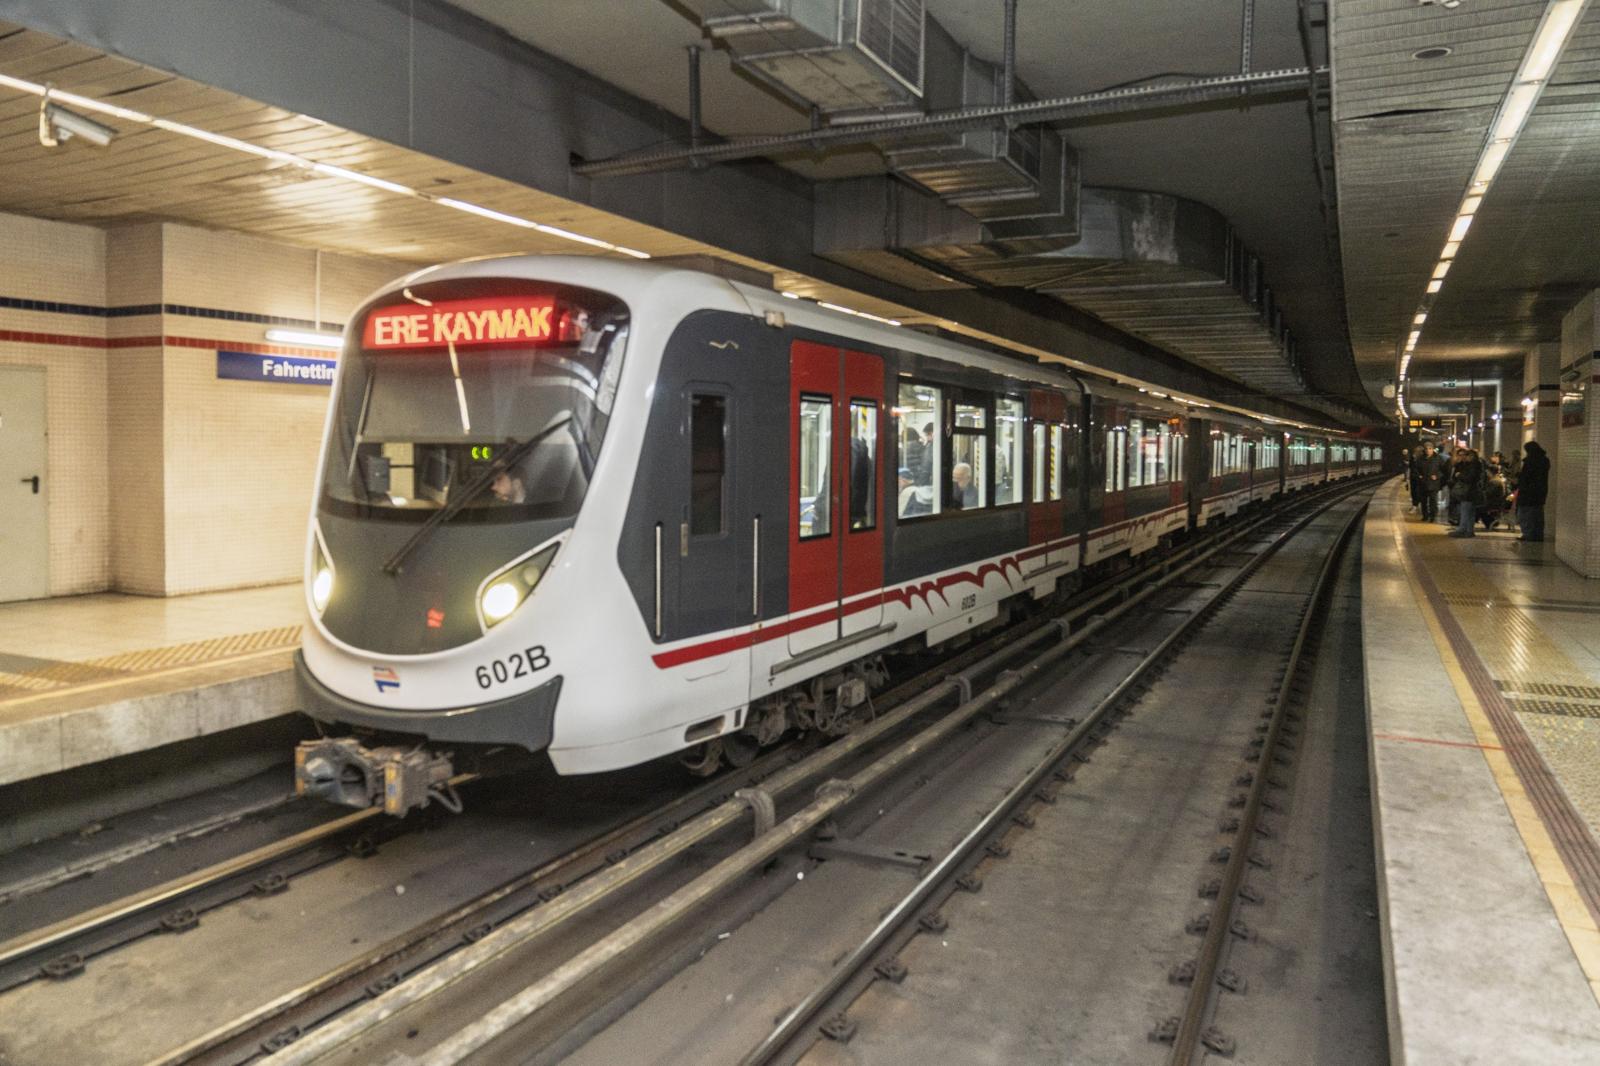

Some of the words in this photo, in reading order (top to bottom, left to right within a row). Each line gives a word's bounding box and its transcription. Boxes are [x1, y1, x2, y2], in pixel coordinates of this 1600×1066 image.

[374, 314, 430, 345] ERE
[432, 306, 554, 342] KAYMAK
[262, 359, 335, 380] Fahrettin
[475, 644, 551, 690] 602B
